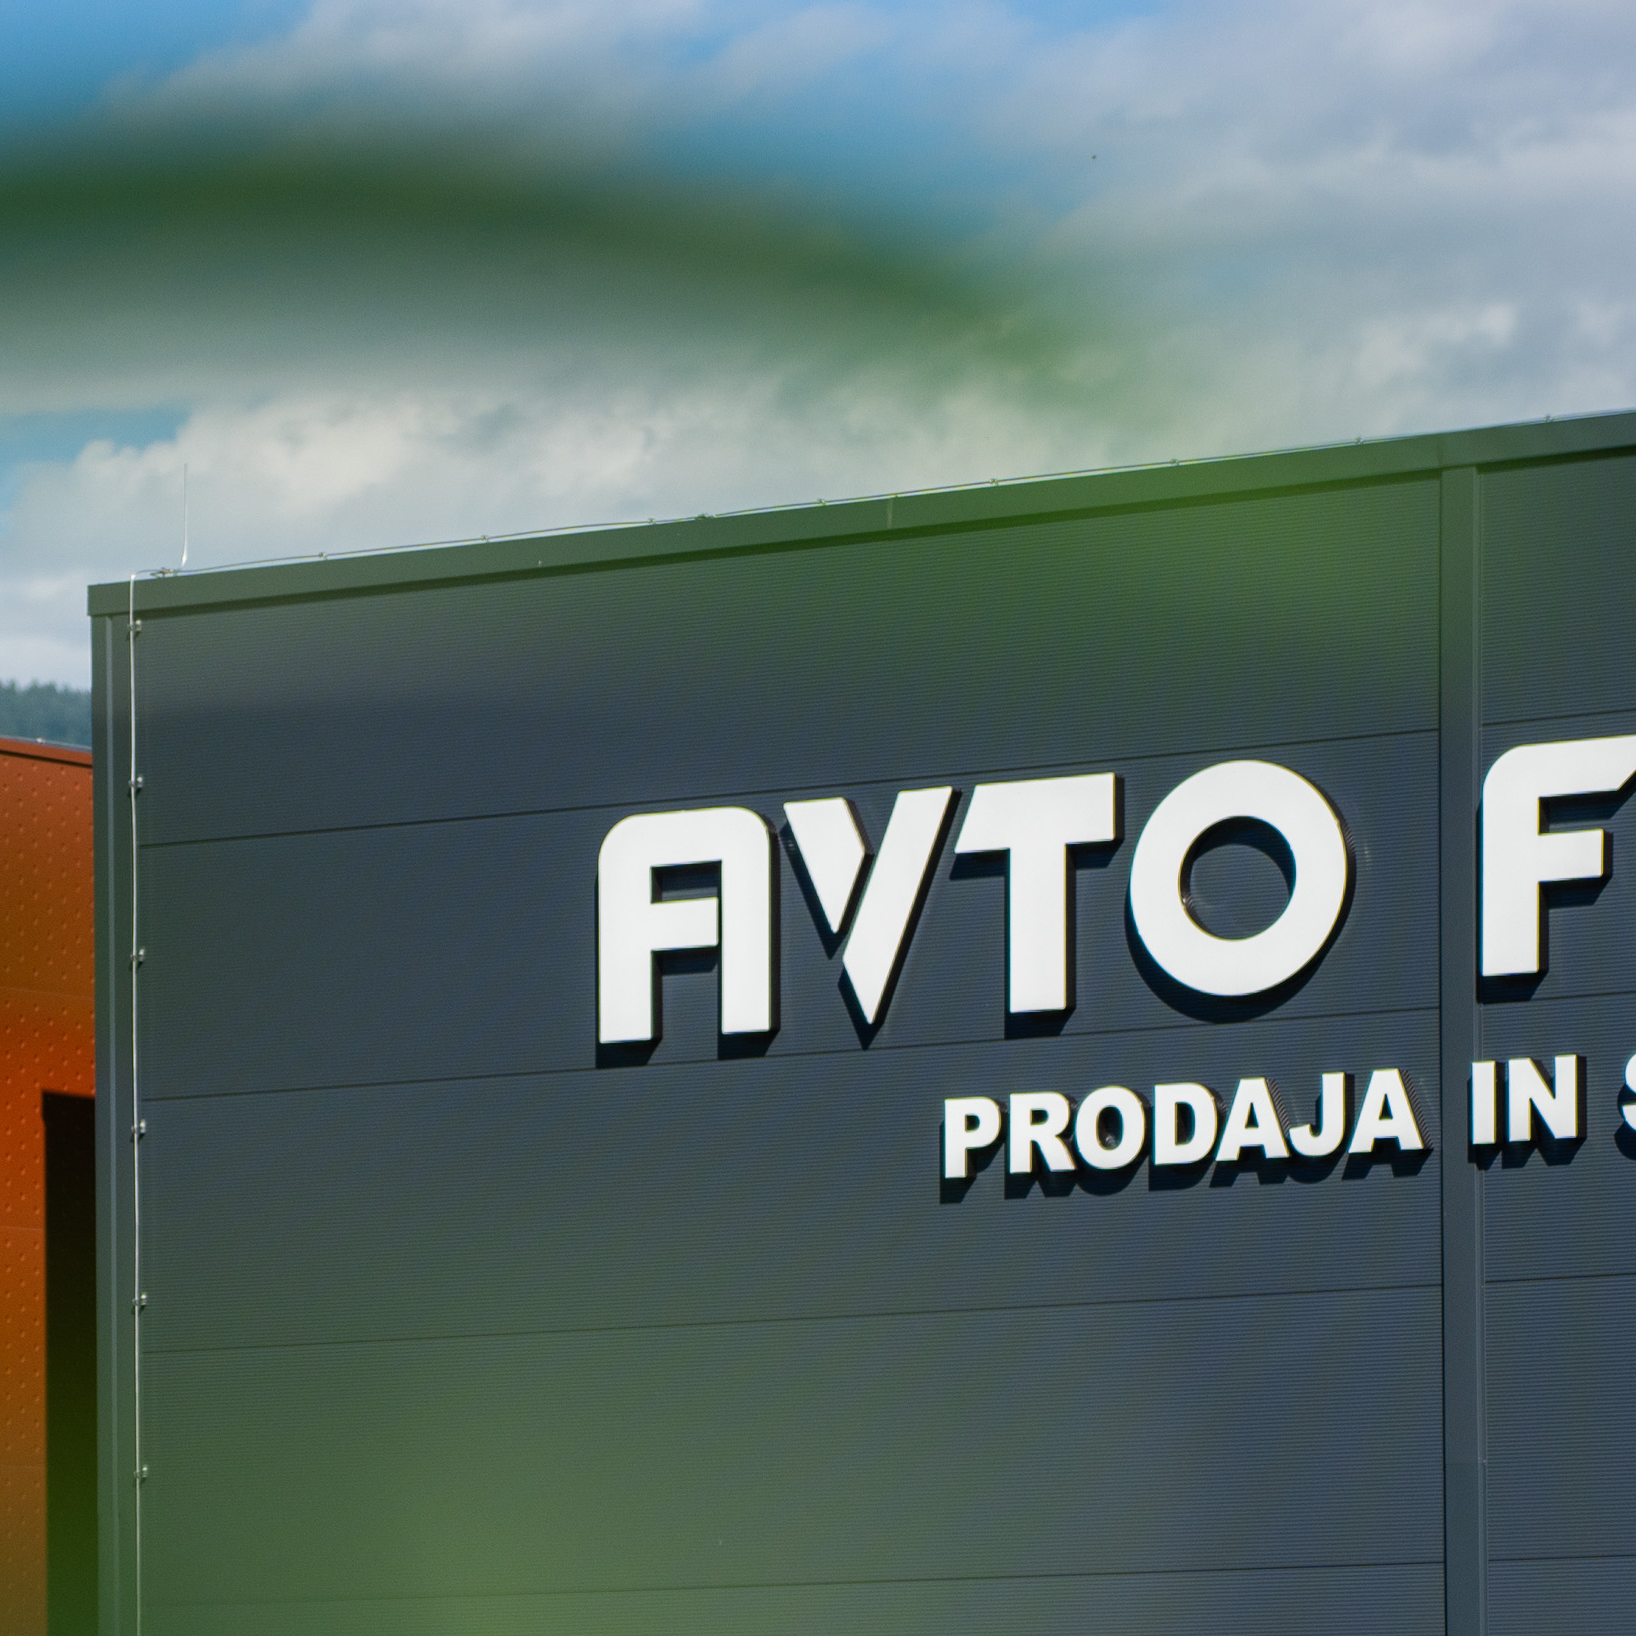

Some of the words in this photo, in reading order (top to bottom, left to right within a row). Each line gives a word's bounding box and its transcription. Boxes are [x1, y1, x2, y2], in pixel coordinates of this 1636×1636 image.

[599, 760, 1350, 1045] AVTO
[943, 1068, 1424, 1181] PRODAJA
[1470, 1054, 1578, 1146] IN
